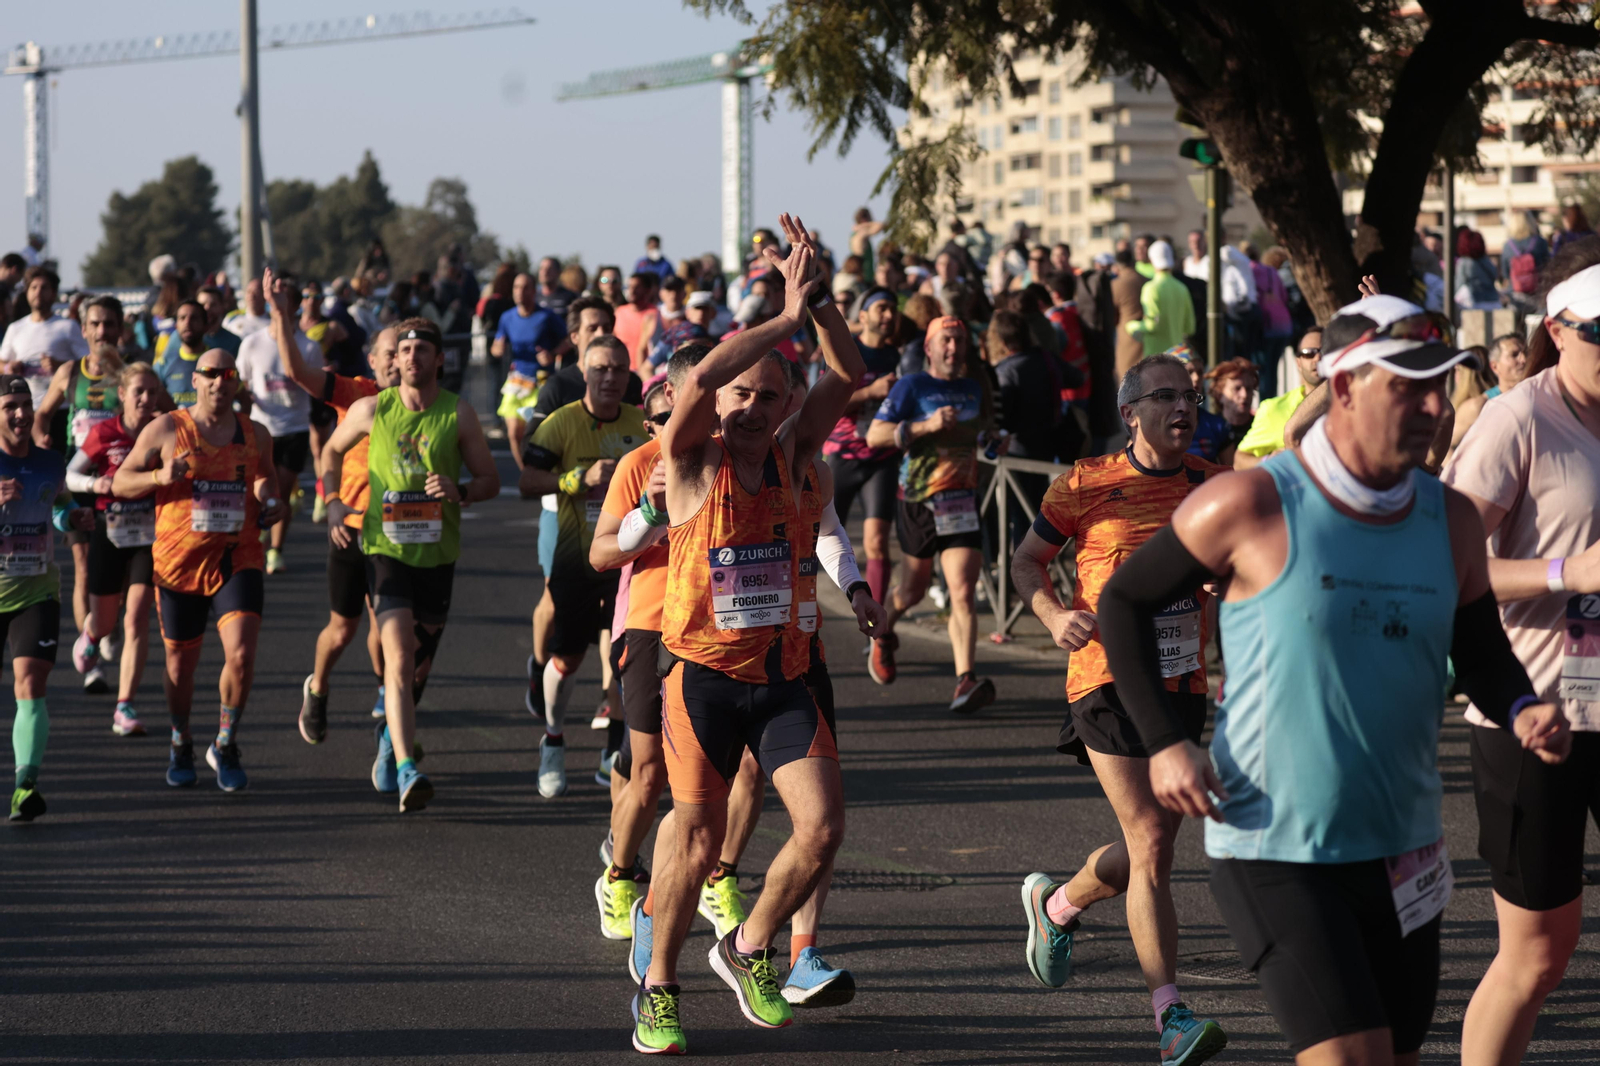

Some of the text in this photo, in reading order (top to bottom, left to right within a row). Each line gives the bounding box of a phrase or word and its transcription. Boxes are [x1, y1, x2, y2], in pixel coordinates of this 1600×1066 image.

[210, 483, 242, 491] ZURICH
[396, 522, 429, 530] TIRAPICOS
[739, 546, 783, 560] ZURICH
[741, 573, 769, 588] 6952
[732, 593, 780, 608] FOGONERO
[1155, 626, 1181, 640] 9575
